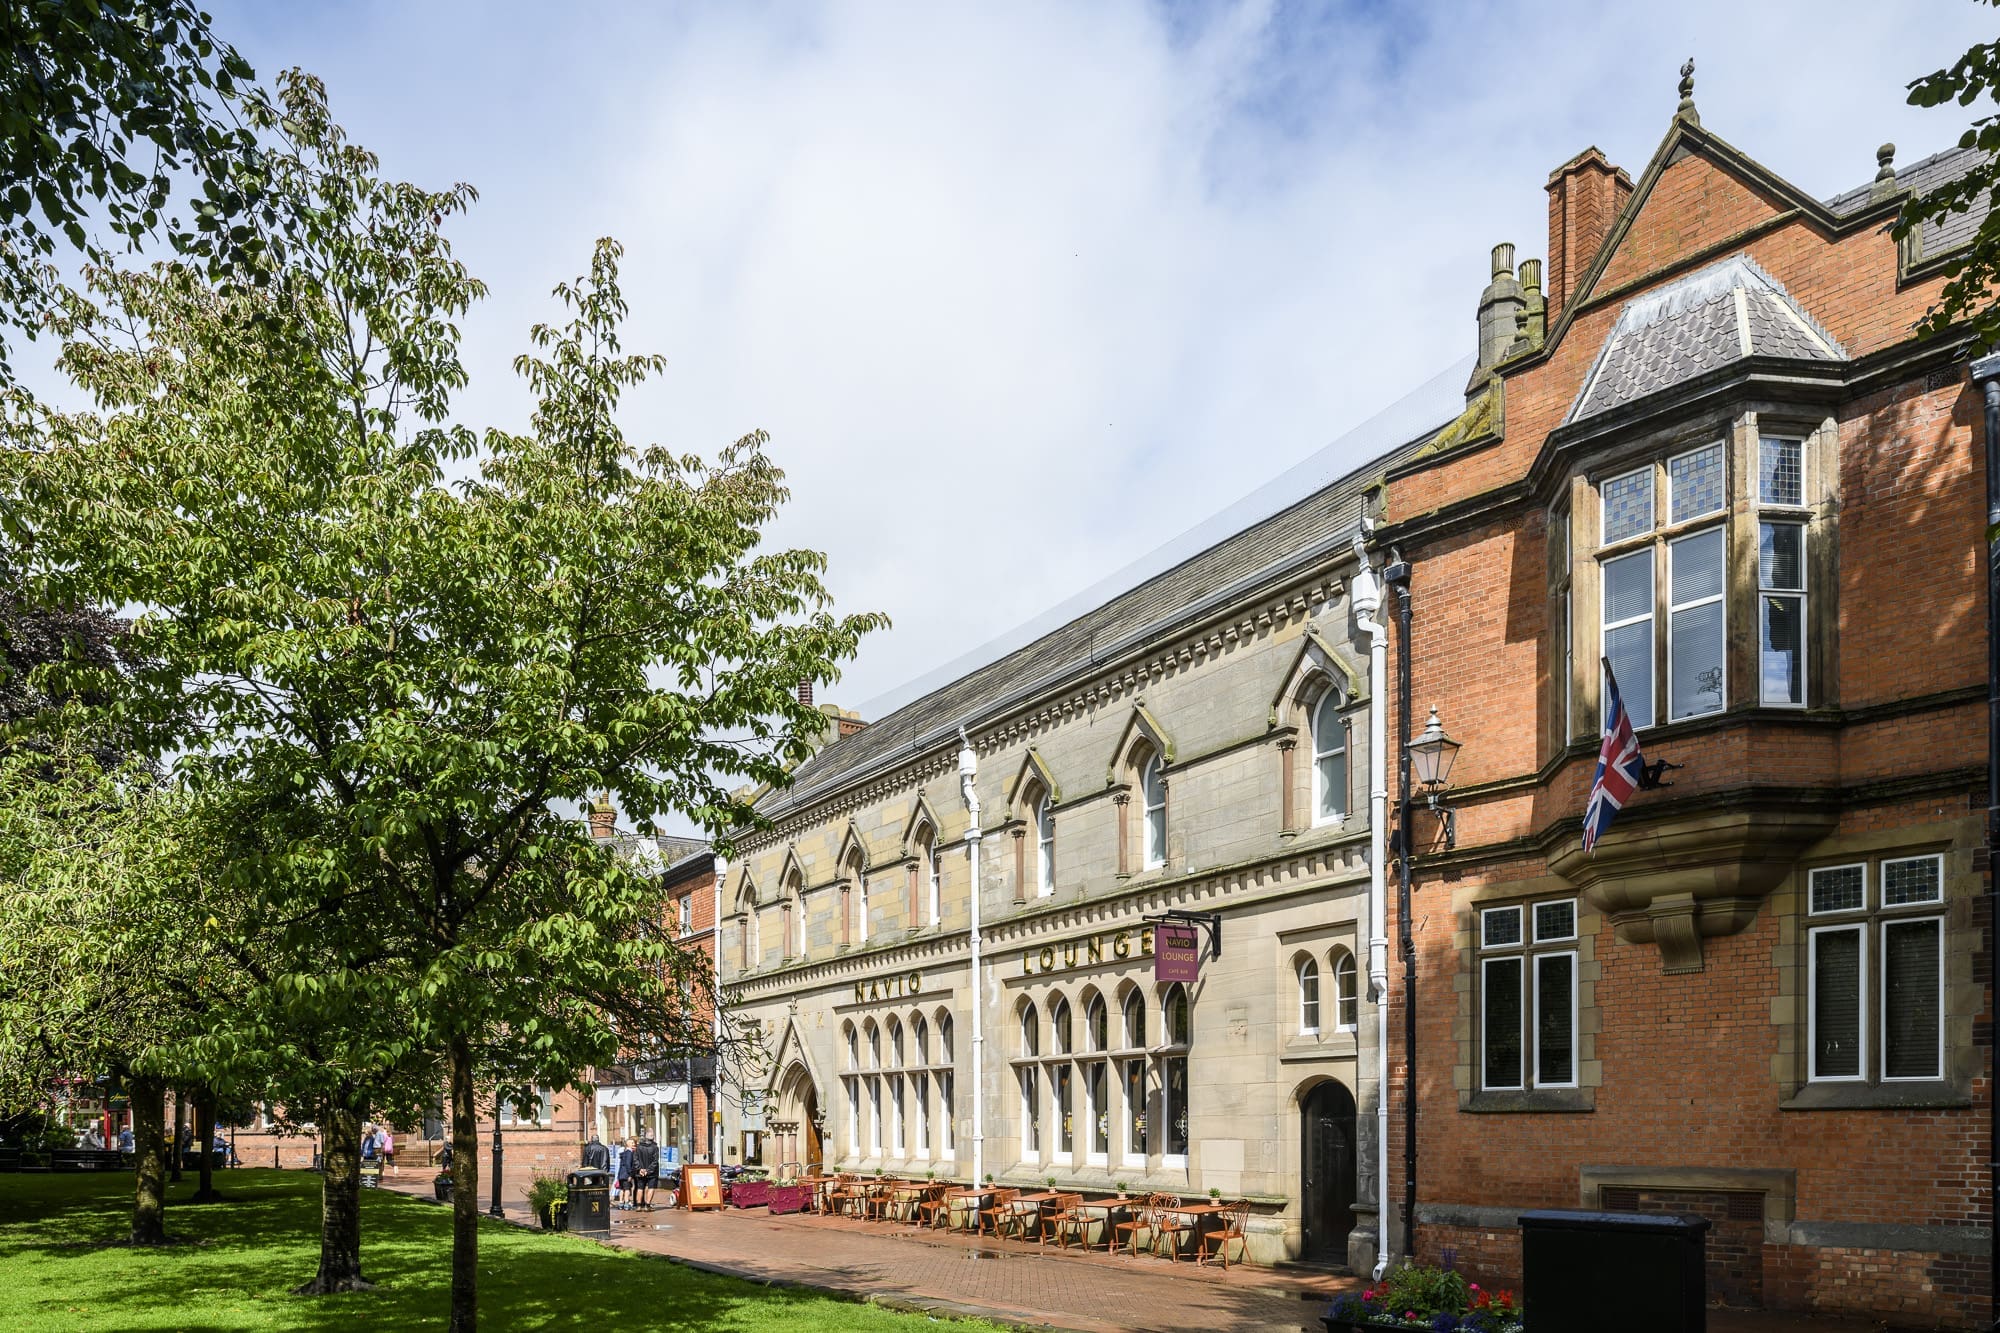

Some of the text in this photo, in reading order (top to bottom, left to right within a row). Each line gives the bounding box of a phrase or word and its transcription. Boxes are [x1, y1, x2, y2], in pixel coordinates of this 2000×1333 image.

[1165, 937, 1190, 948] NAVIO
[1162, 951, 1194, 962] LOUNGE
[855, 927, 1154, 1004] NAVIO LOUNGE
